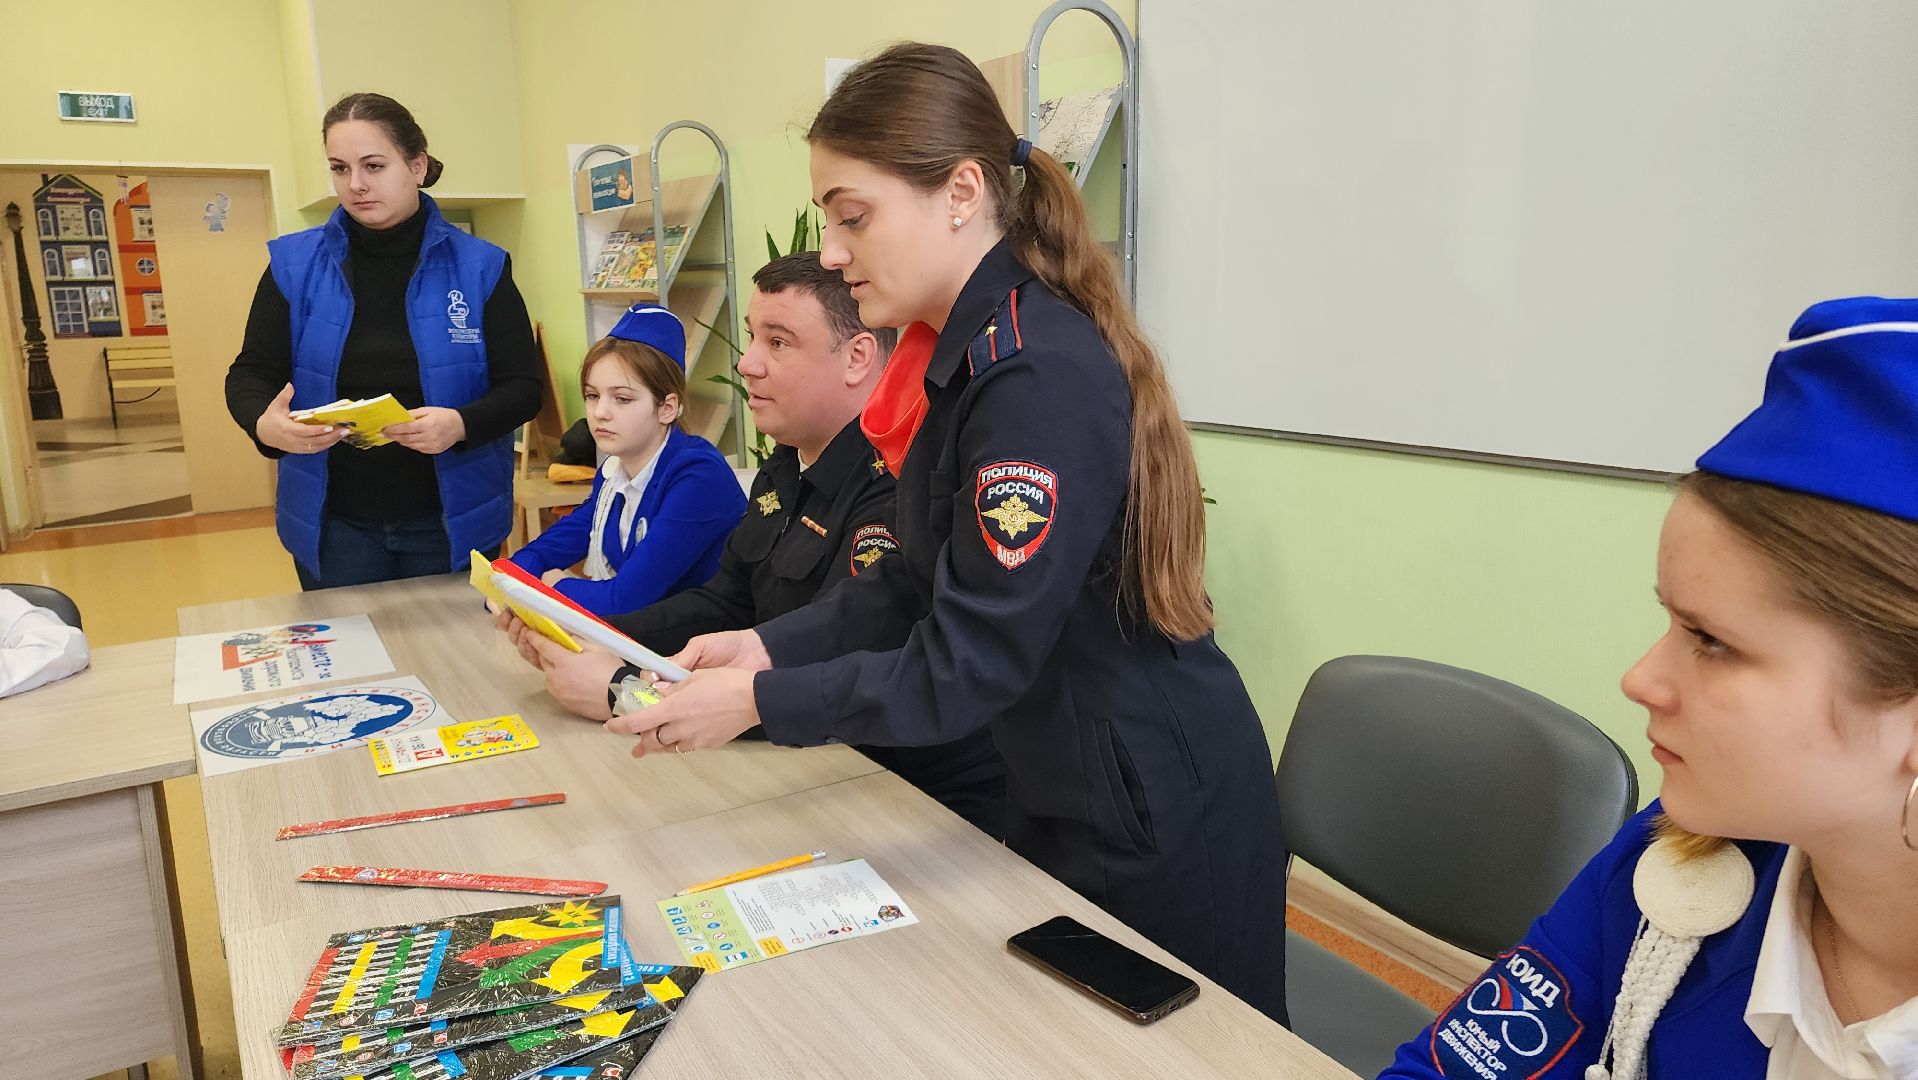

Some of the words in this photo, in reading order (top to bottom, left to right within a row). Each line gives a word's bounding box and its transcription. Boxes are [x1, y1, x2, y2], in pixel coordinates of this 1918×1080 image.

[78, 96, 115, 109] ВЫХОД
[981, 466, 1053, 490] ПОЛИЦИЯ
[987, 482, 1044, 505] РОССИЯ
[997, 545, 1025, 567] МВД
[1505, 953, 1561, 1008] ЮИД
[1448, 1019, 1507, 1072] ИНСПЕКТОР
[1465, 1019, 1501, 1053] ЮНЫЙ
[1438, 1028, 1498, 1080] ДВИЖЕНИЯ
